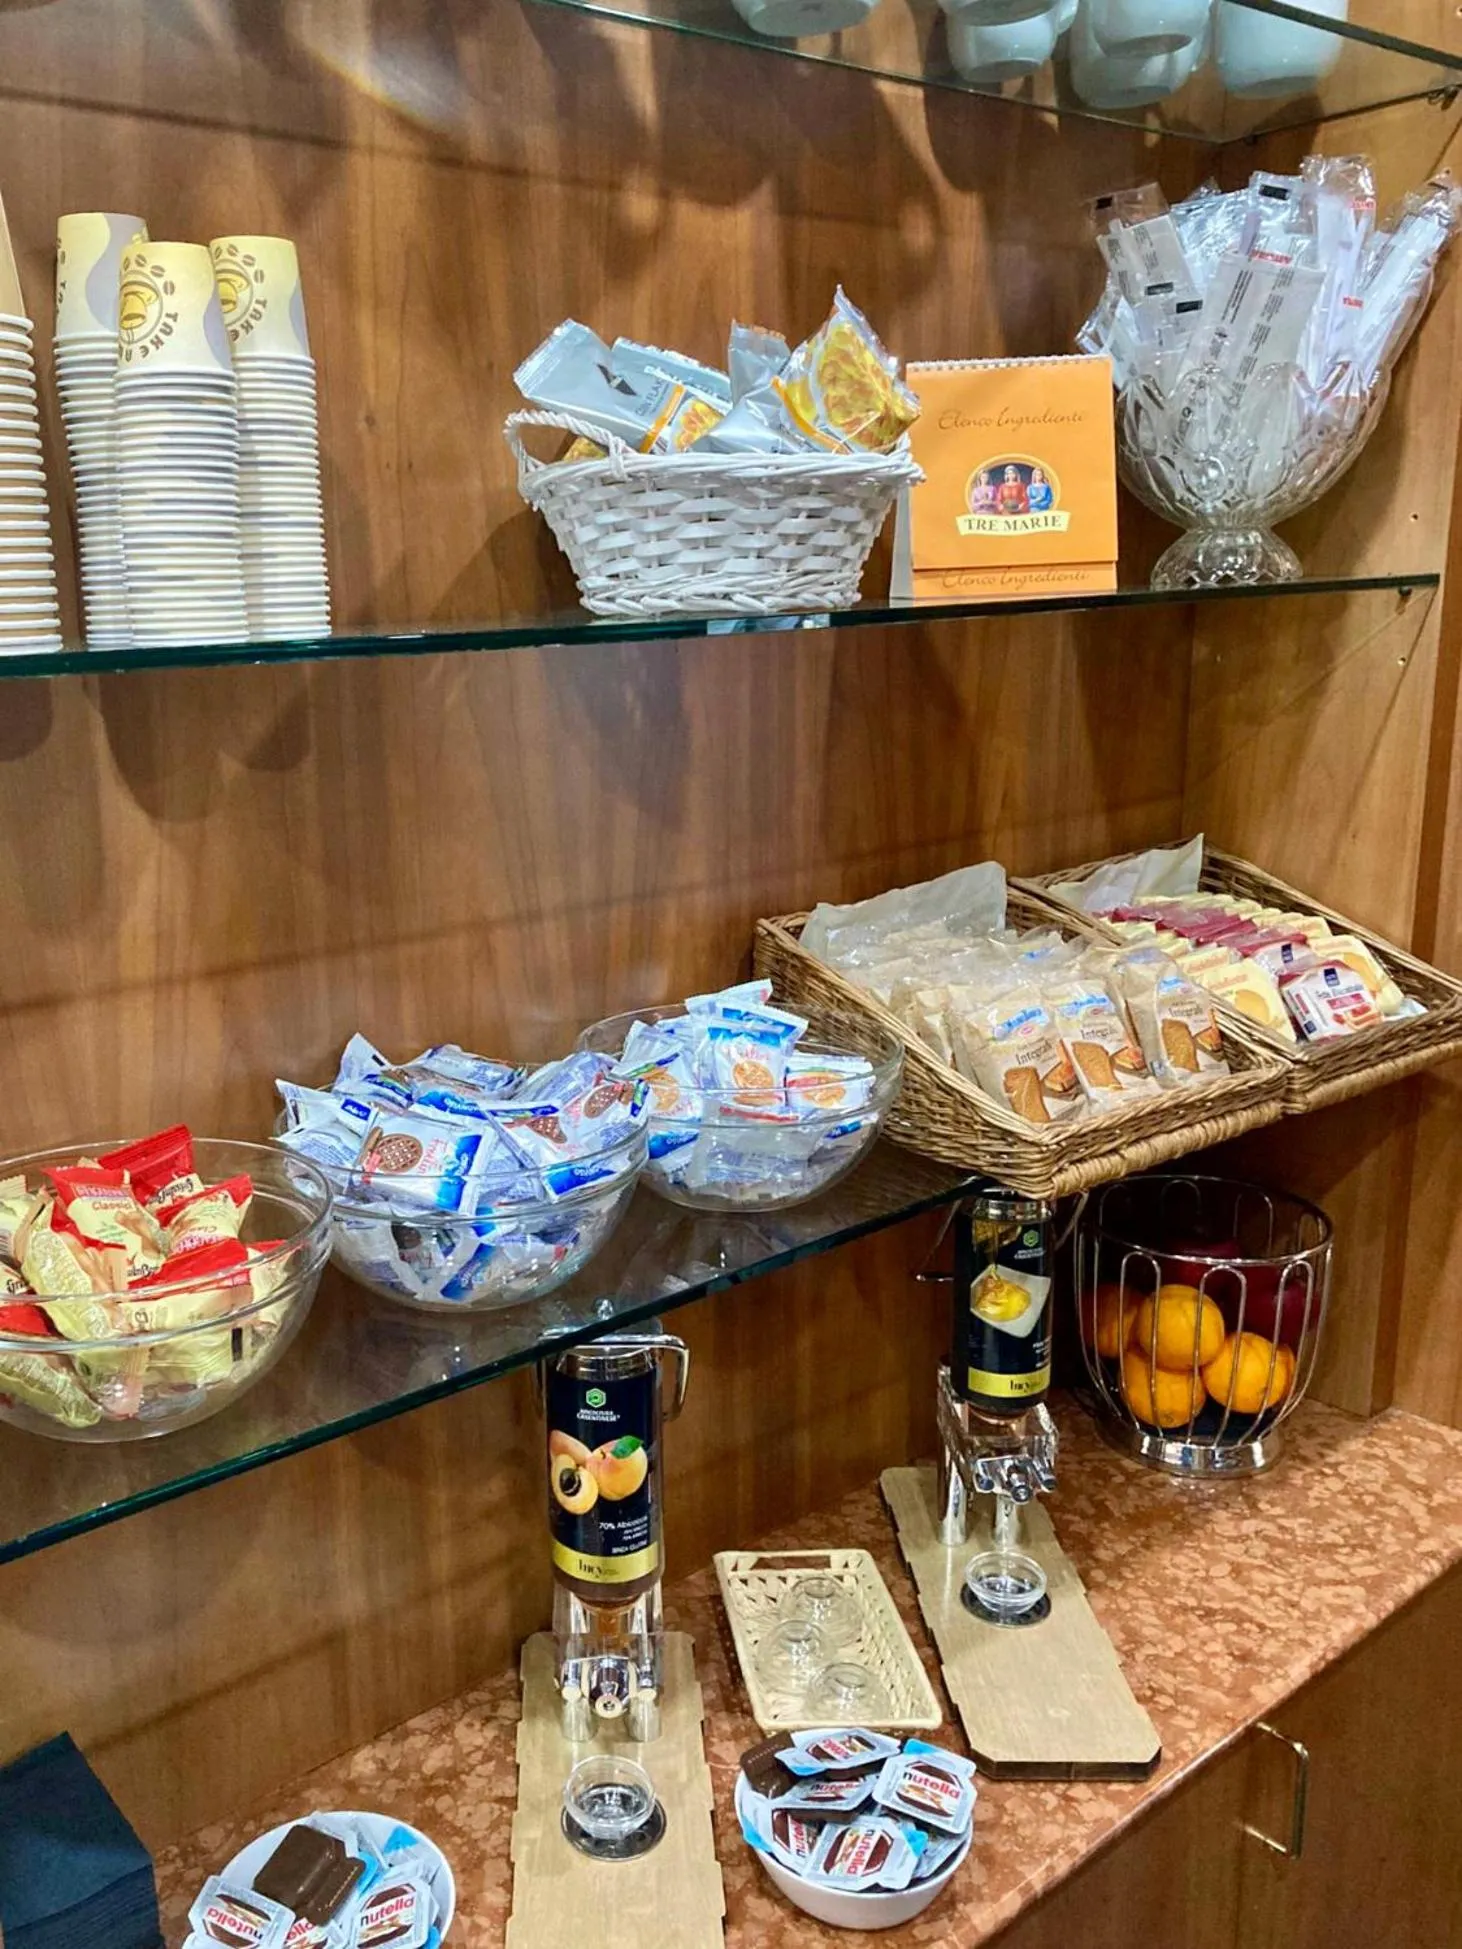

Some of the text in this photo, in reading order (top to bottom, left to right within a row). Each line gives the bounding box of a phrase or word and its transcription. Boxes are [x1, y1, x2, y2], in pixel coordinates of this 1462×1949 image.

[938, 405, 1083, 433] Elenco Ingredienti
[964, 514, 1062, 532] TRE MARIE
[942, 566, 1087, 592] Elenco Ingredienti
[903, 1771, 961, 1800] nutella
[846, 1828, 876, 1875] nutella
[206, 1906, 264, 1940] nutella
[358, 1898, 415, 1927] nutella
